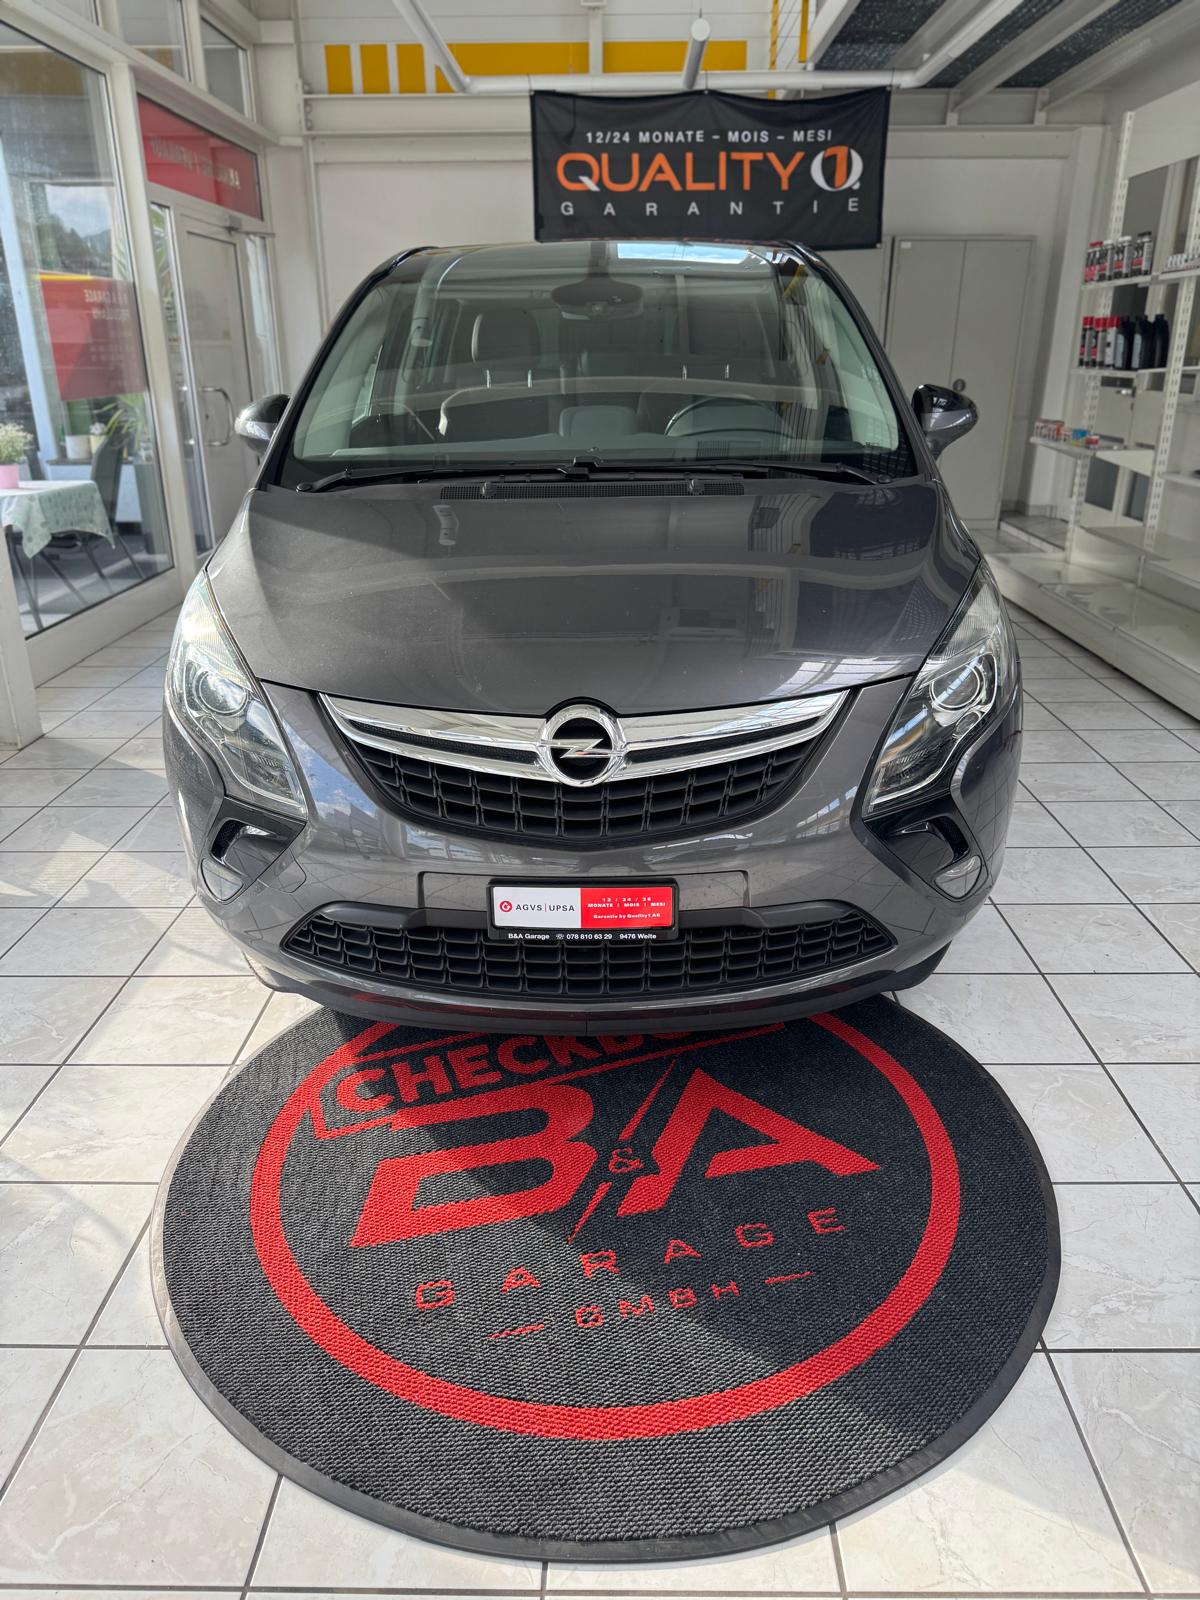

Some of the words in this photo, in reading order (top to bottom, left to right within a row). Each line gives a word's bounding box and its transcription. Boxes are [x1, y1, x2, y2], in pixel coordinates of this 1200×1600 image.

[586, 131, 631, 144] 12/24
[638, 130, 705, 143] MONATE
[728, 130, 769, 143] MOIS
[793, 128, 832, 142] MESI
[556, 151, 805, 192] QUALITY
[560, 197, 859, 216] GARANTIE
[549, 904, 575, 912] UPSA
[525, 933, 550, 941] Garage
[619, 932, 636, 940] 9476
[350, 1083, 598, 1248] B
[617, 1070, 880, 1217] A
[415, 1207, 845, 1310] GARAGE
